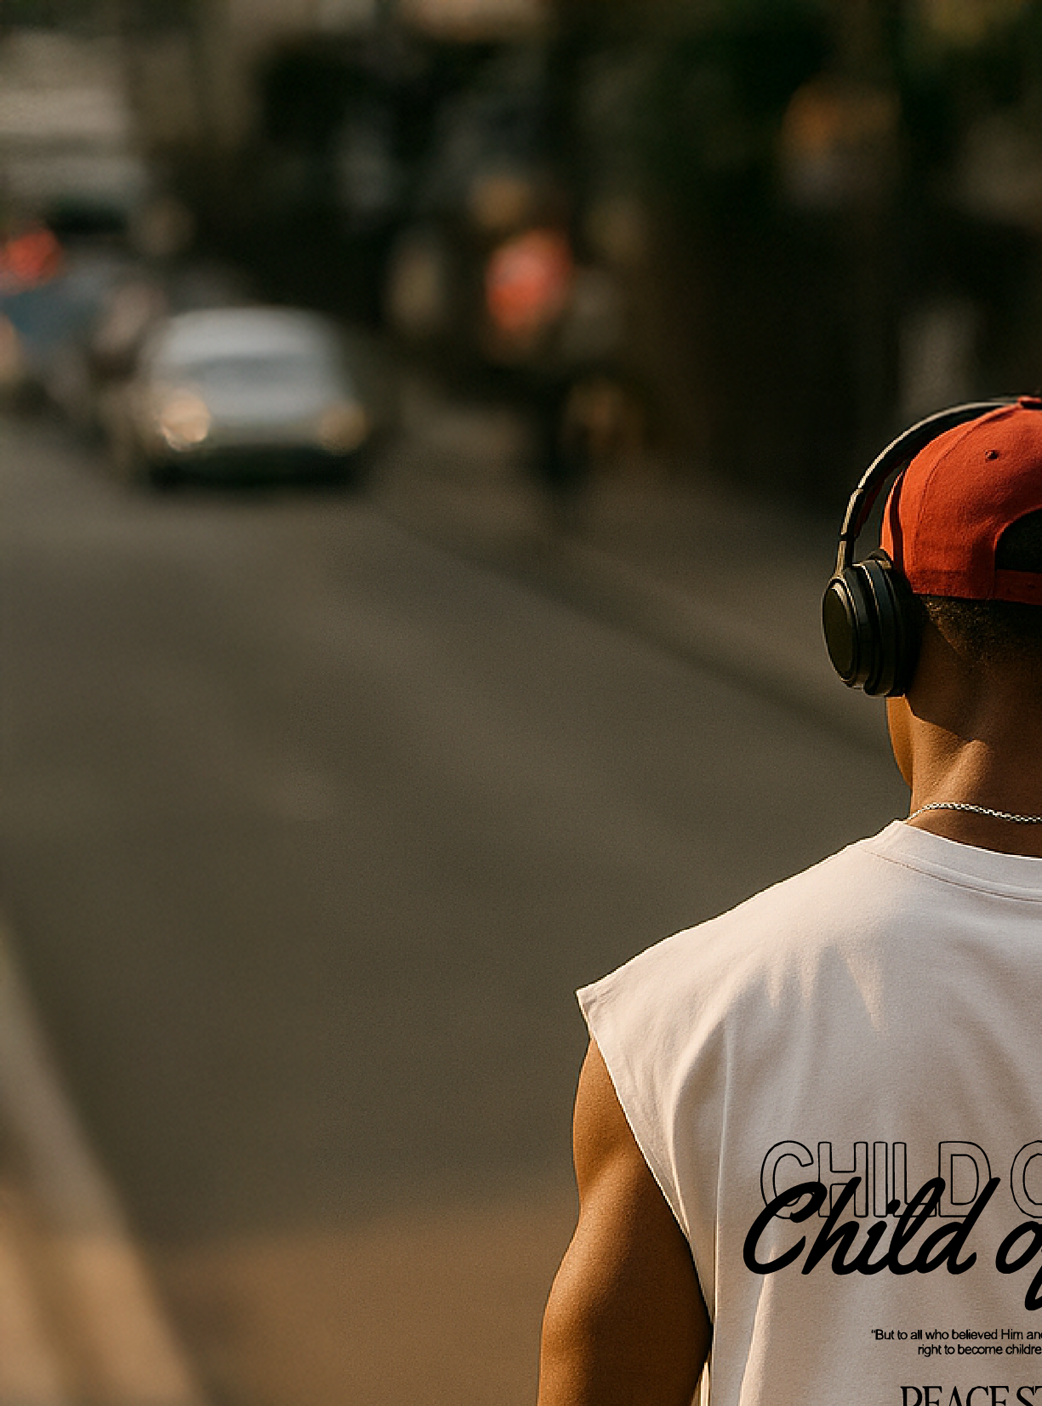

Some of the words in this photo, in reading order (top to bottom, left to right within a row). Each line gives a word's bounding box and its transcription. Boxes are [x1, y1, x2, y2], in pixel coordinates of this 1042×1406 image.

[760, 1140, 992, 1219] CHILD
[743, 1177, 1001, 1275] Child
[897, 1330, 908, 1340] to
[910, 1329, 923, 1340] all
[925, 1329, 949, 1340] who
[952, 1329, 998, 1340] believed
[1001, 1329, 1023, 1340] Him
[918, 1344, 941, 1357] right
[944, 1345, 956, 1355] to
[958, 1344, 1003, 1355] become
